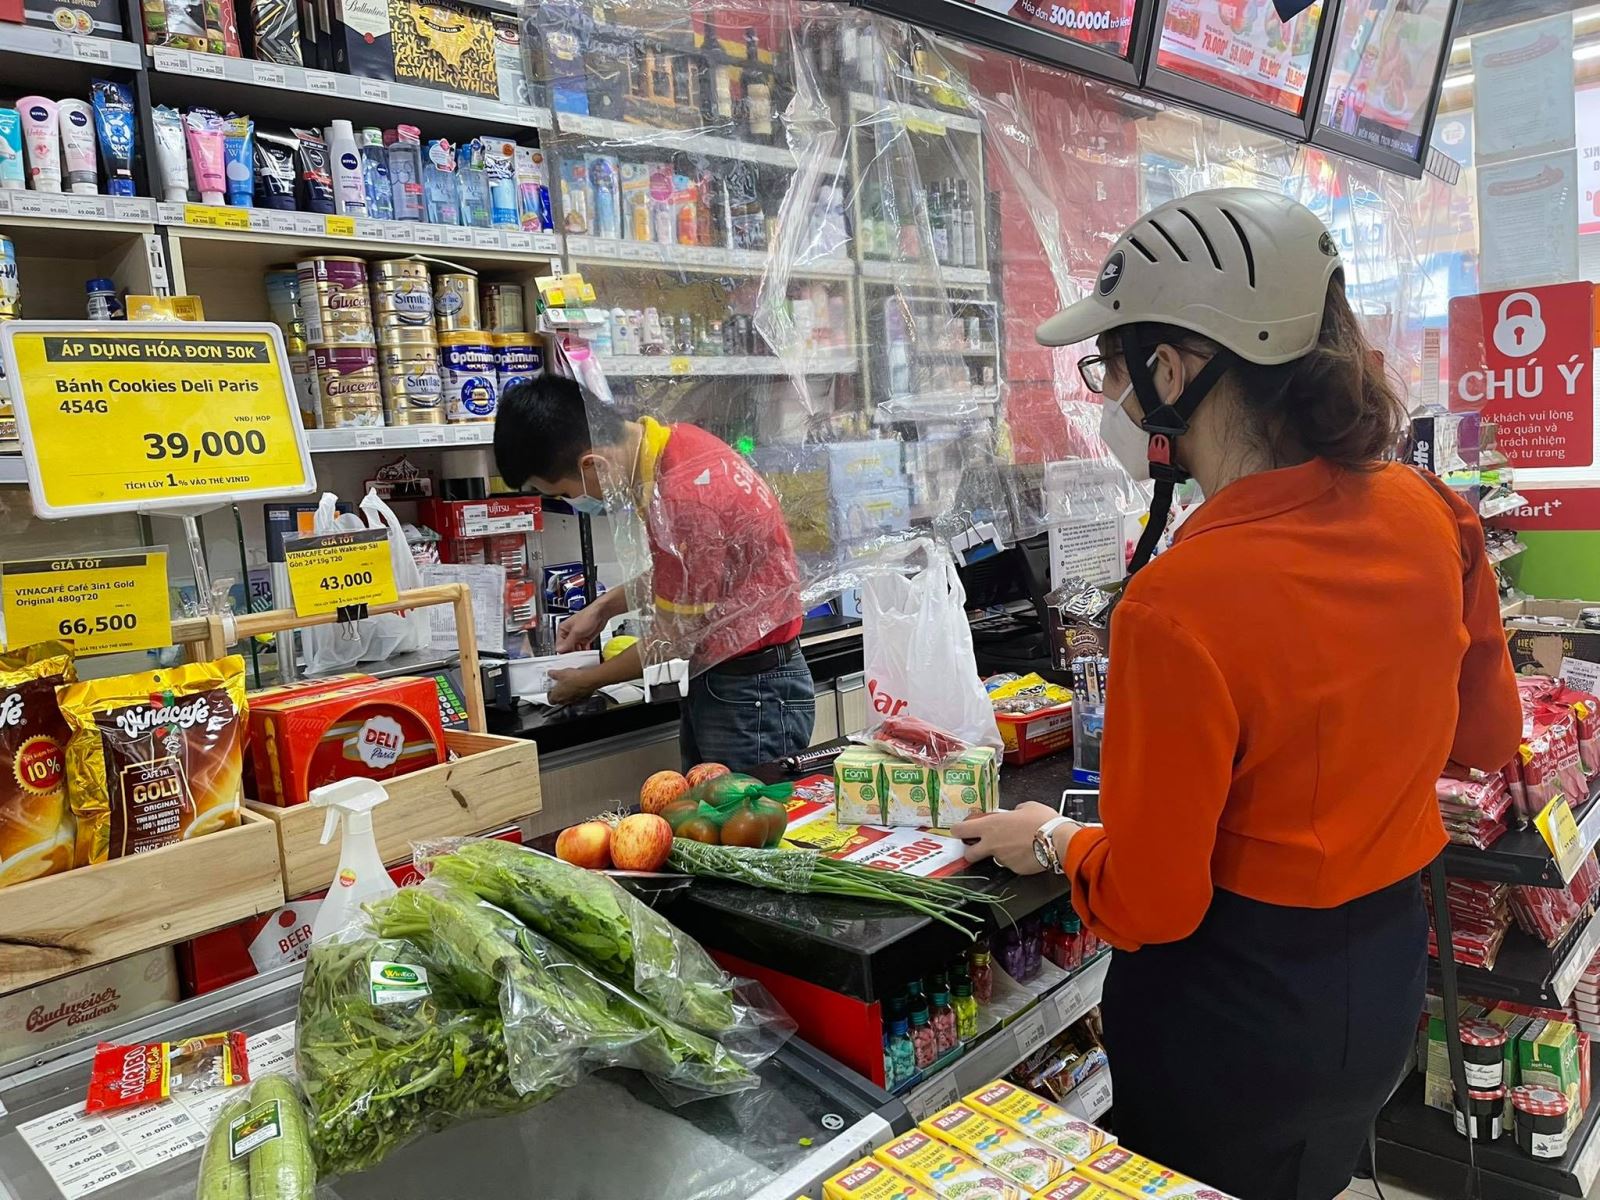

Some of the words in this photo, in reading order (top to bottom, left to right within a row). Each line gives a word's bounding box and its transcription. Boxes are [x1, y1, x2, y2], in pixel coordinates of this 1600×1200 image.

[1022, 0, 1035, 14] Hóa
[1035, 8, 1048, 21] đơn
[1050, 4, 1110, 30] 300.000đ
[61, 340, 85, 357] ÁP
[89, 344, 140, 360] DỤNG
[145, 340, 181, 357] HÓA
[185, 344, 222, 358] ĐƠN
[226, 346, 256, 359] 50K
[56, 378, 103, 393] Bánh
[108, 379, 177, 393] Cookies
[181, 379, 214, 392] Deli
[218, 379, 259, 392] Paris
[1458, 357, 1543, 402] CHÚ
[1557, 354, 1584, 395] Ý
[59, 400, 108, 414] 454G
[1494, 411, 1526, 423] khách
[1529, 413, 1546, 422] vui
[1549, 411, 1574, 424] lòng
[1544, 423, 1557, 432] và
[143, 429, 266, 463] 39,000
[1500, 435, 1528, 447] trách
[1531, 436, 1566, 447] nhiệm
[1505, 449, 1518, 459] và
[1521, 448, 1533, 458] tư
[1536, 448, 1566, 460] trang
[124, 481, 146, 490] TÍCH
[225, 475, 250, 484] VINID
[321, 537, 337, 546] GIÁ
[323, 547, 338, 555] Café
[339, 545, 367, 554] Wake-up
[51, 557, 74, 571] GIÁ
[78, 557, 101, 570] TỐT
[15, 584, 65, 596] VINACAFÉ
[67, 582, 89, 592] Café
[91, 581, 111, 590] 3in1
[113, 580, 135, 590] Gold
[320, 571, 373, 590] 43,000
[16, 596, 55, 608] Original
[57, 593, 98, 605] 480gT20
[59, 613, 137, 636] 66,500
[116, 697, 209, 738] Vinacafé
[364, 728, 398, 749] DELI
[370, 748, 396, 760] Paris
[133, 778, 179, 803] GOLD
[143, 799, 179, 812] ORIGINAL
[278, 924, 312, 954] BEER
[26, 987, 120, 1031] Budweiser
[120, 1045, 146, 1099] HARIBO
[82, 1171, 118, 1190] 23.000
